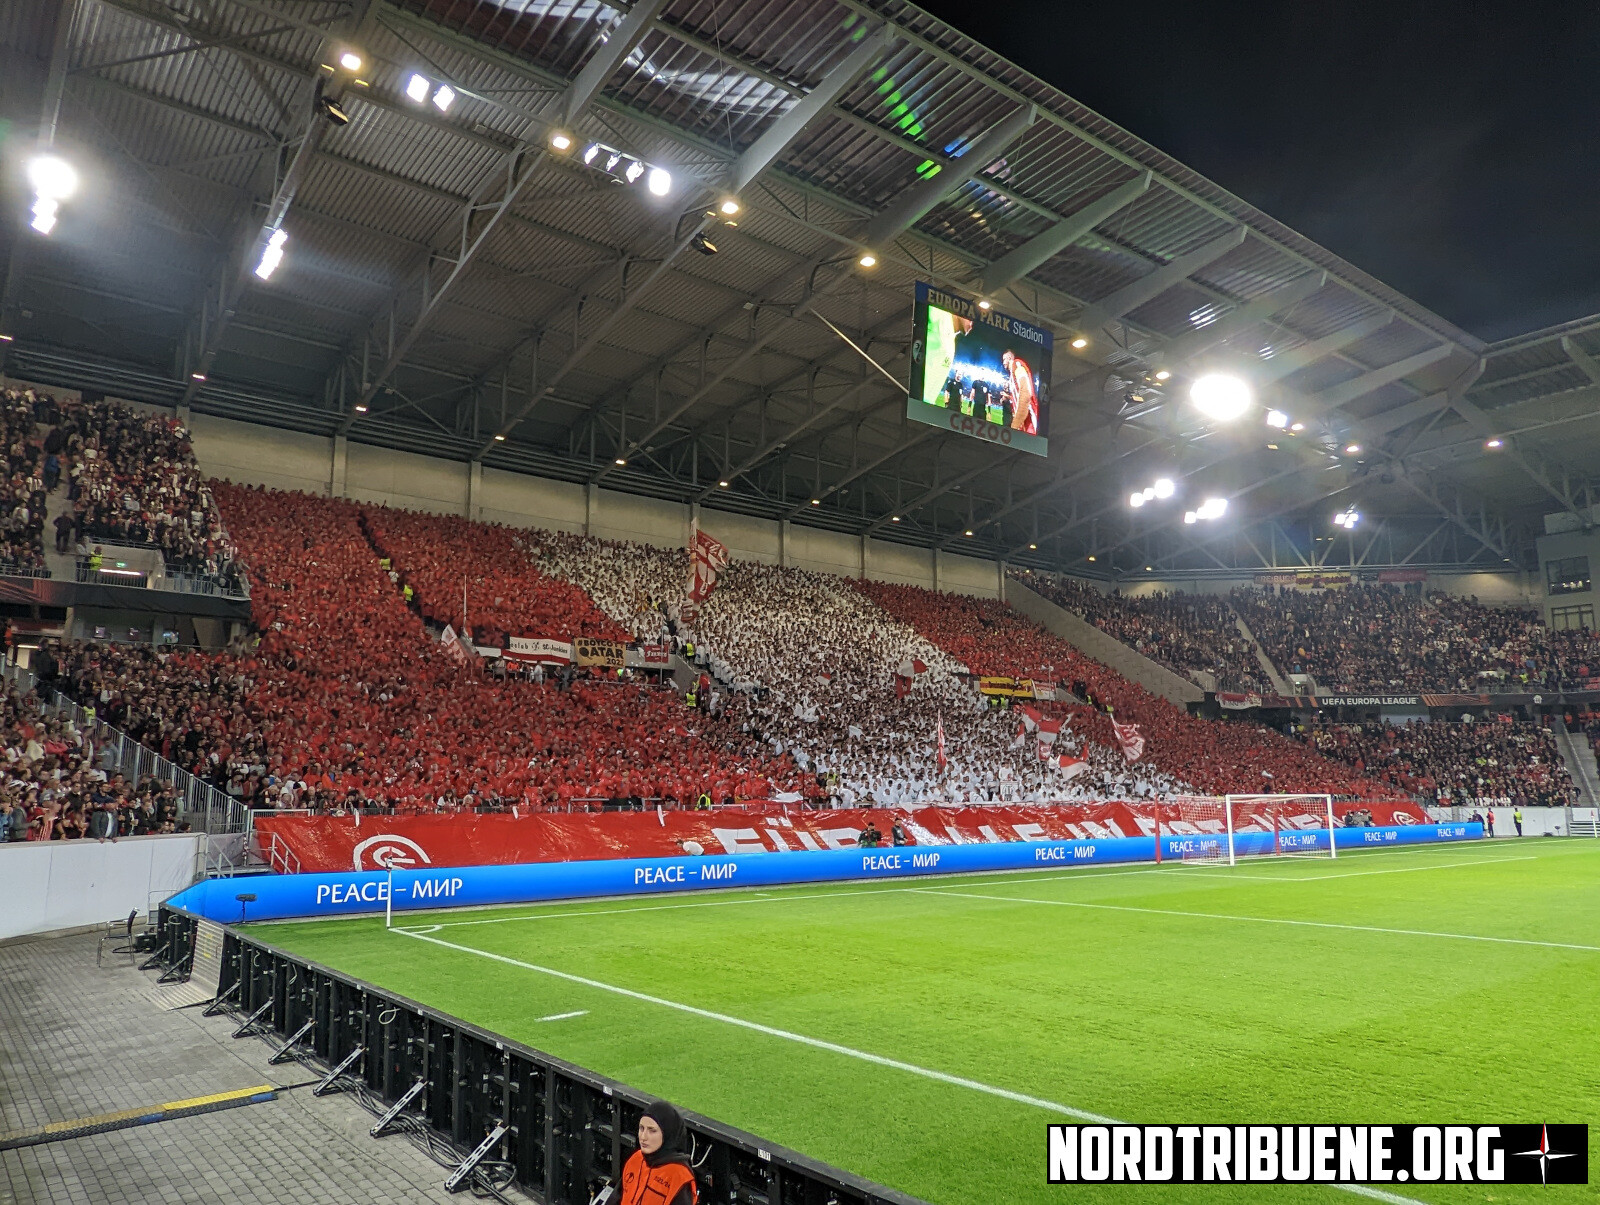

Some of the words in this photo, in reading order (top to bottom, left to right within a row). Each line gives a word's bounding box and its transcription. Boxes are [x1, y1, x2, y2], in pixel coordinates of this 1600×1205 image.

[927, 288, 976, 320] EUROPA
[980, 307, 1011, 333] PARK
[1013, 321, 1043, 344] Stadion
[950, 413, 1012, 445] CAZOO
[579, 647, 624, 660] QATAR
[606, 658, 624, 666] 2022
[1347, 697, 1381, 705] EUROPA
[1382, 697, 1417, 705] LEAGUE
[1364, 832, 1381, 841] PEACE
[1437, 828, 1452, 837] PEACE
[1035, 847, 1066, 860] PEACE
[1074, 845, 1096, 858] МИР
[1169, 840, 1194, 853] PEACE
[863, 855, 901, 870] PEACE
[913, 853, 940, 868] МИР
[634, 866, 685, 884] PEACE
[701, 863, 738, 880] МИР
[316, 881, 389, 904] PEACE
[412, 878, 463, 899] МИР
